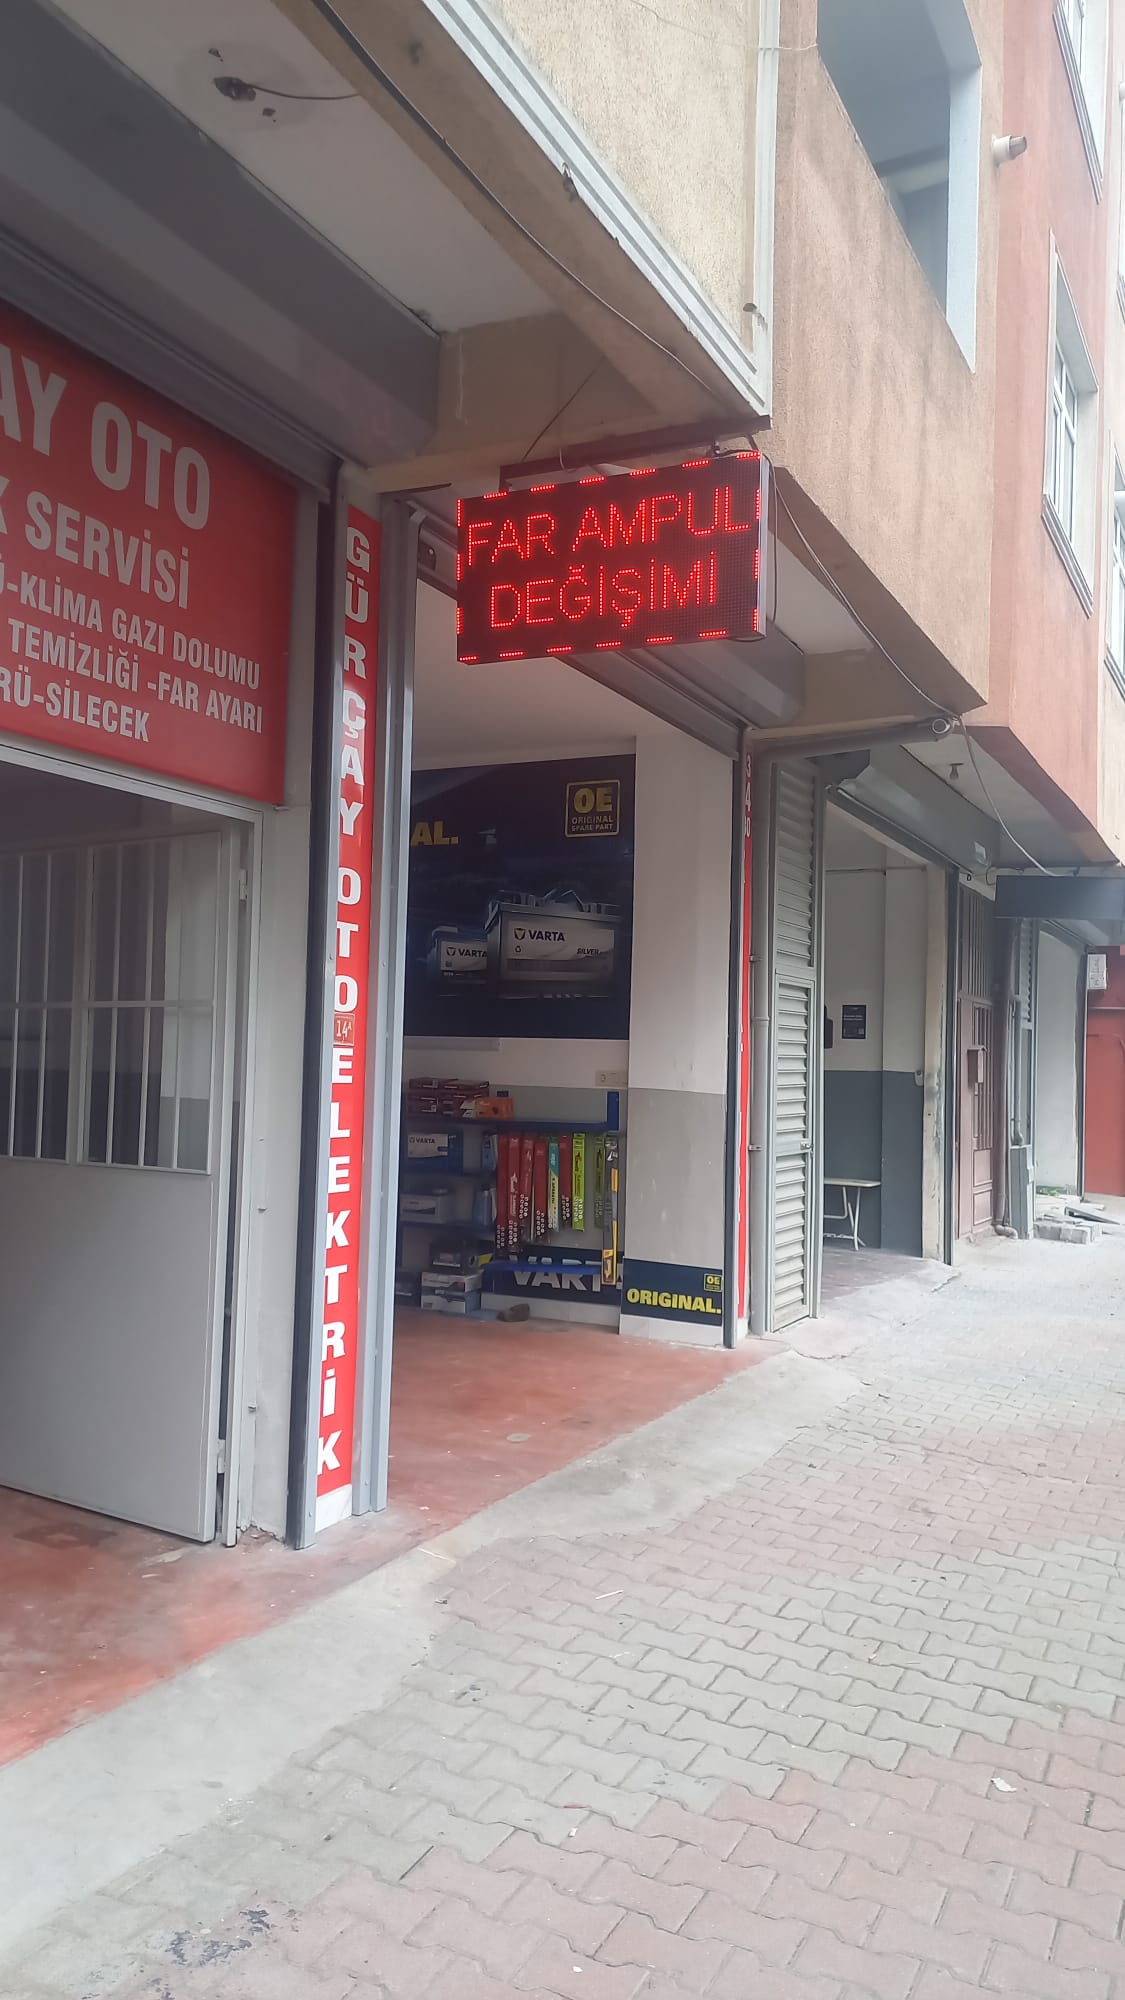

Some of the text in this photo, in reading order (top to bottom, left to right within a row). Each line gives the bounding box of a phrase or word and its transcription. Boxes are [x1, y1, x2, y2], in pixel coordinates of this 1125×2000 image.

[91, 401, 211, 530] OTO
[25, 491, 190, 609] SERVİSİ
[467, 486, 750, 566] FAR AMPUL
[490, 551, 718, 629] DEĞİŞİMİ
[8, 618, 262, 734] TEMİZLİĞİ -FAR AYARI
[112, 607, 165, 656] GAZI
[173, 631, 260, 690] DOLUMU
[338, 526, 370, 836] GÜRÇAY
[571, 815, 614, 825] ORIGINAL
[573, 787, 613, 814] OE
[334, 867, 362, 1013] OTO
[458, 948, 488, 958] VARTA
[528, 929, 566, 942] VARTA
[317, 1047, 353, 1476] ELEKTRİK
[509, 1254, 623, 1292] VART
[626, 1288, 722, 1315] ORIGINAL.
